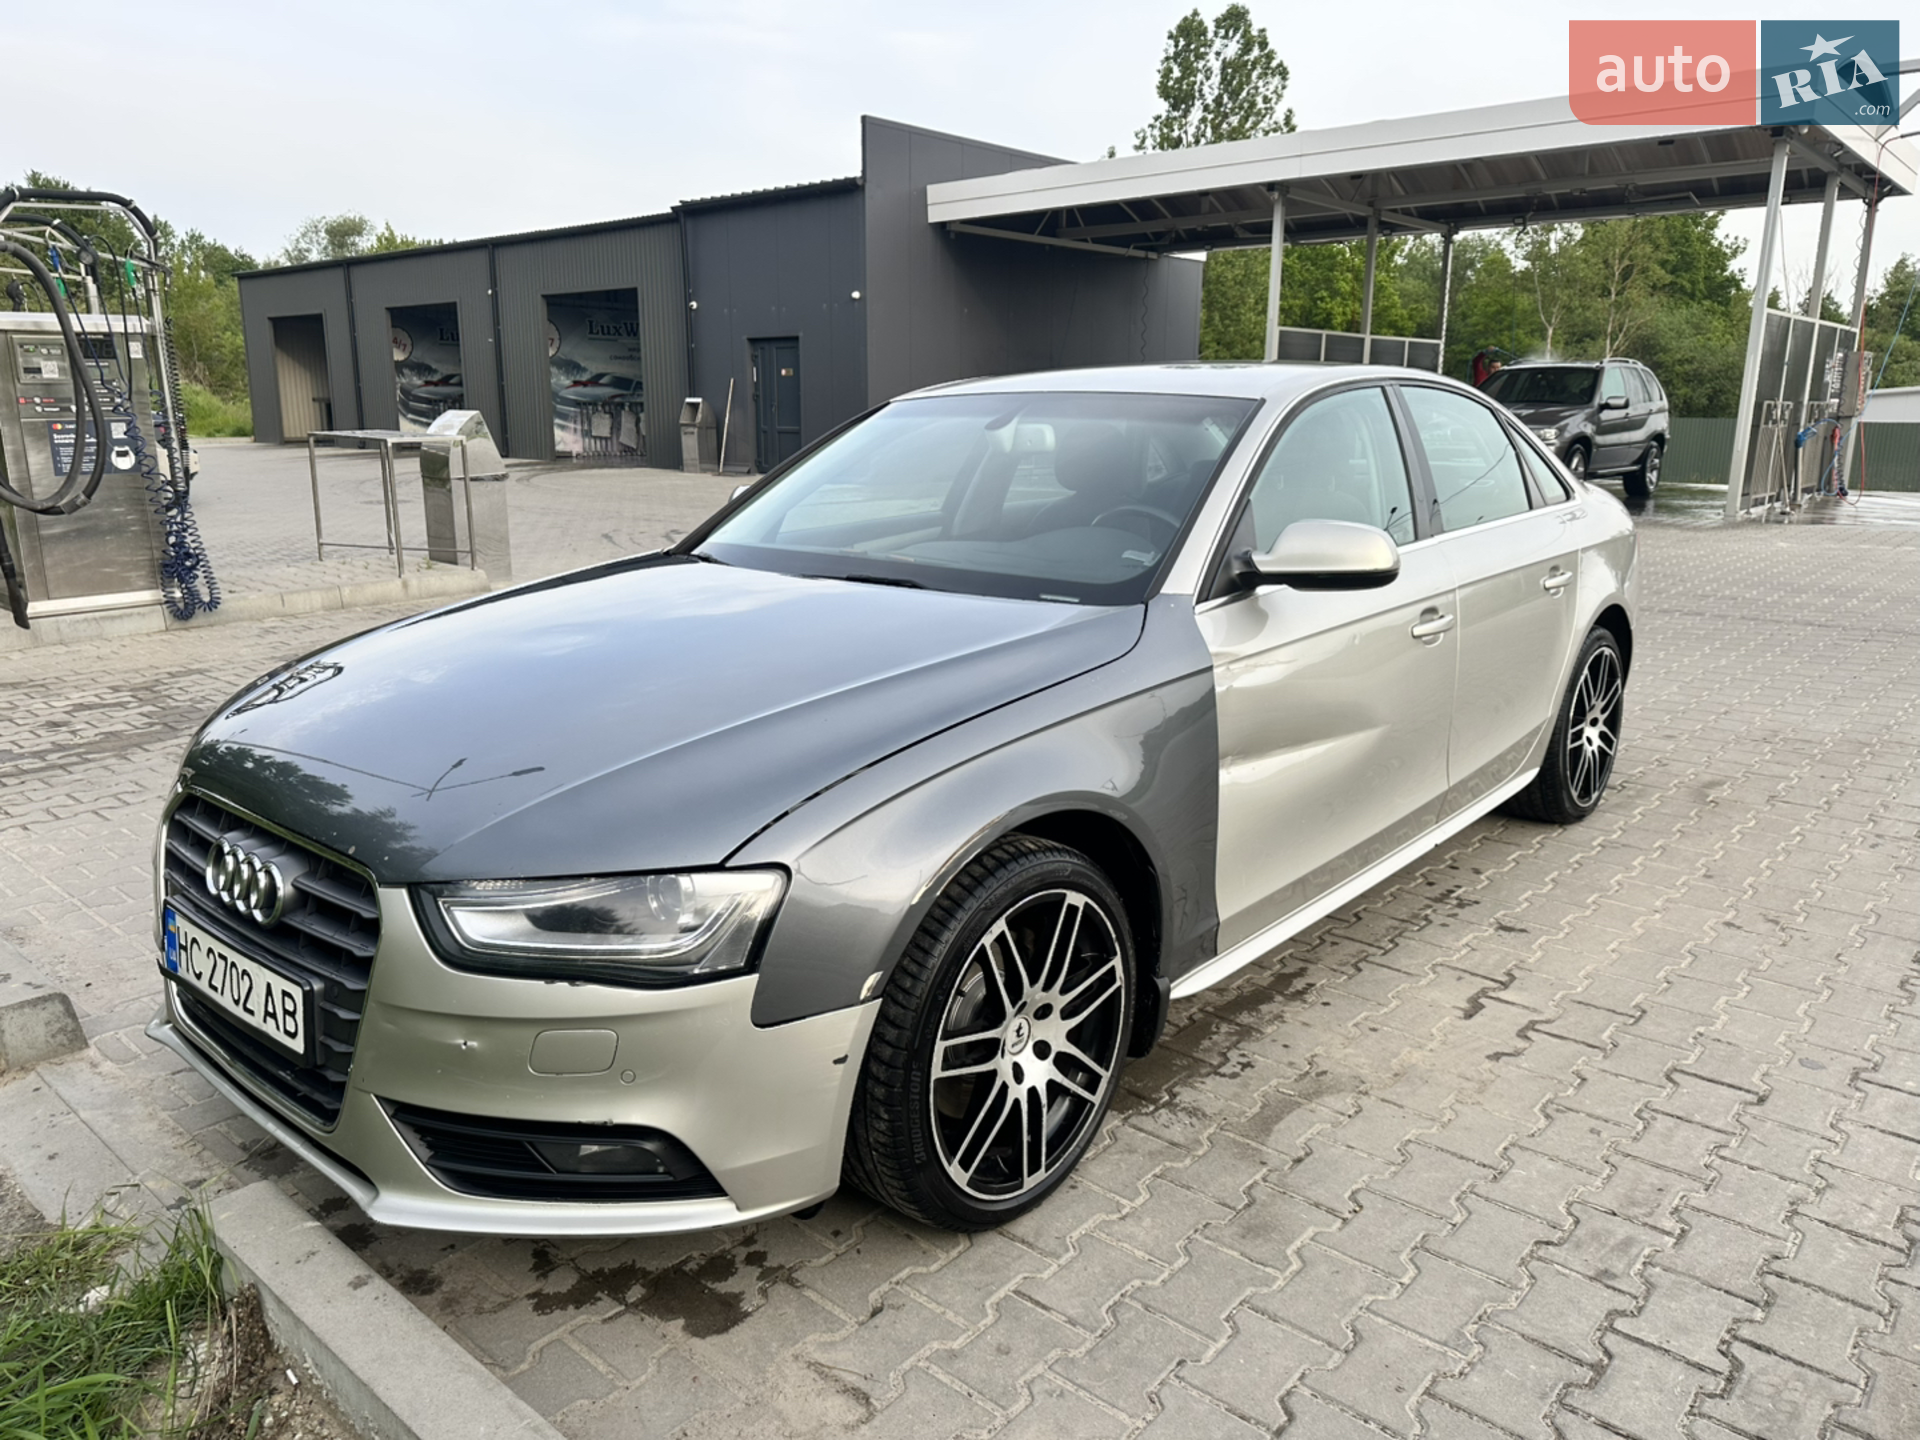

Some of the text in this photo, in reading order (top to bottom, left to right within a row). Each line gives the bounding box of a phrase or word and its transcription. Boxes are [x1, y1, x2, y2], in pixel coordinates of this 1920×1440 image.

[177, 925, 299, 1040] HC 2702 AB
